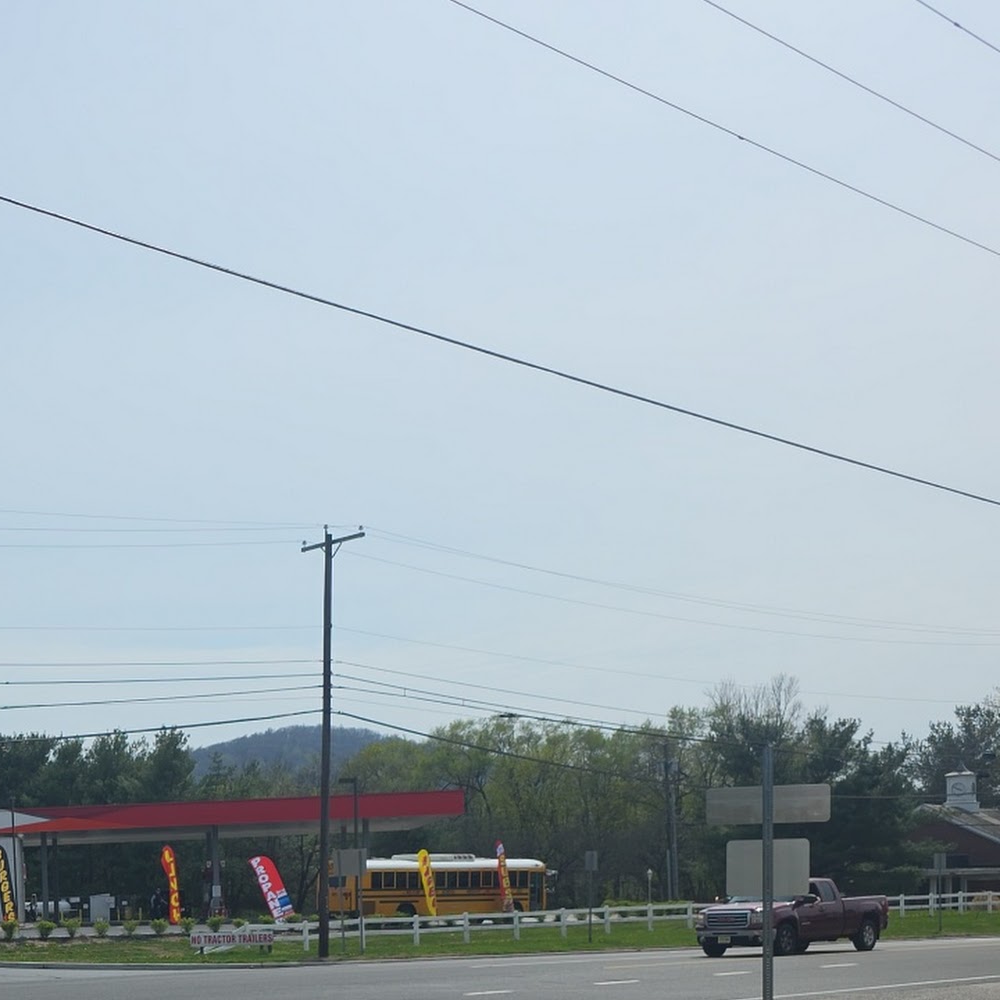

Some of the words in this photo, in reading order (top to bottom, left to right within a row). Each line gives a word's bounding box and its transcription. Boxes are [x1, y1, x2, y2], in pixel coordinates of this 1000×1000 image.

[250, 856, 285, 919] PROPANE
[191, 935, 201, 945] NO
[203, 934, 236, 945] TRACTOR
[238, 933, 274, 944] TRAILERS
